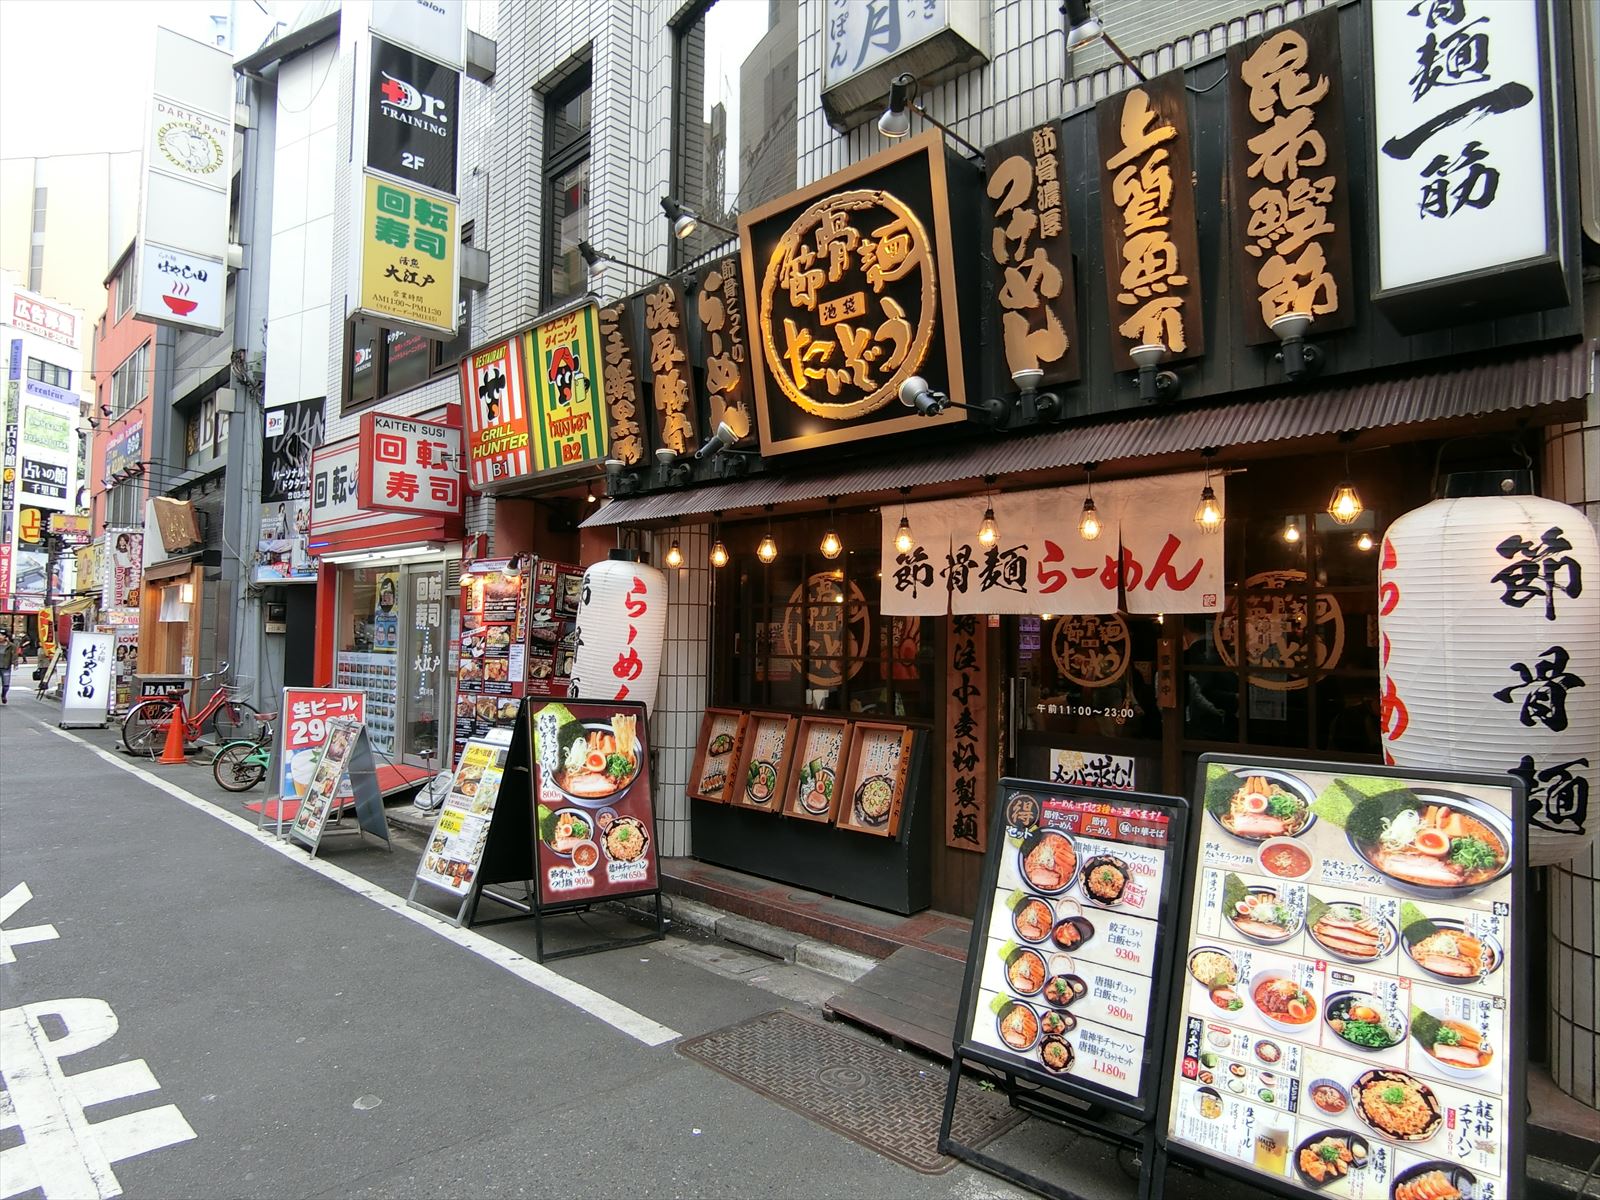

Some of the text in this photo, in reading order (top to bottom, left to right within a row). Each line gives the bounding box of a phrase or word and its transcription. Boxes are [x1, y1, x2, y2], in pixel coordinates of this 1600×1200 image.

[157, 103, 227, 137] DARTS BAR
[381, 105, 447, 137] TRAINING
[401, 152, 425, 170] 2F
[1032, 126, 1063, 239] 節骨濃厚
[376, 184, 449, 232] 回転
[375, 215, 447, 261] 寿司
[781, 207, 923, 312] 節骨麺
[986, 155, 1070, 374] つけめん
[384, 264, 436, 288] 大江戸
[722, 258, 745, 363] 節骨こってり
[822, 297, 858, 321] 池袋
[543, 313, 577, 334] エスニック
[545, 325, 578, 349] ダイニング
[783, 296, 916, 397] たいぞう
[475, 345, 507, 368] RESTAURANT
[698, 271, 752, 439] らーめん
[375, 417, 446, 438] KAITEN SUSI
[481, 424, 515, 442] GRILL
[546, 406, 592, 439] hunter
[375, 432, 449, 472] 回転
[472, 433, 529, 459] HUNTER
[562, 441, 582, 462] B2
[24, 461, 67, 485] 占いの館
[492, 461, 509, 477] B1
[386, 471, 457, 507] 寿司
[21, 510, 41, 539] 占
[1380, 536, 1410, 766] らーめ
[77, 645, 98, 700] はやし田
[1490, 526, 1591, 835] 節骨麺
[291, 695, 359, 720] 生ビール
[1036, 703, 1135, 719] 午前11:00～23:00
[1053, 755, 1135, 788] メンバー求む!
[1048, 817, 1073, 830] らーめん
[1085, 825, 1112, 836] らーめん
[1128, 861, 1157, 877] 980円
[1107, 933, 1141, 949] 白飯セット
[1115, 946, 1140, 963] 930円
[1093, 987, 1128, 1005] 白飯セット
[1107, 1004, 1134, 1021] 980円
[1092, 1058, 1126, 1080] 1,180円
[1242, 1106, 1255, 1149] 生ビール
[1456, 1103, 1473, 1159] チャーハン
[1474, 1100, 1494, 1139] 龍神
